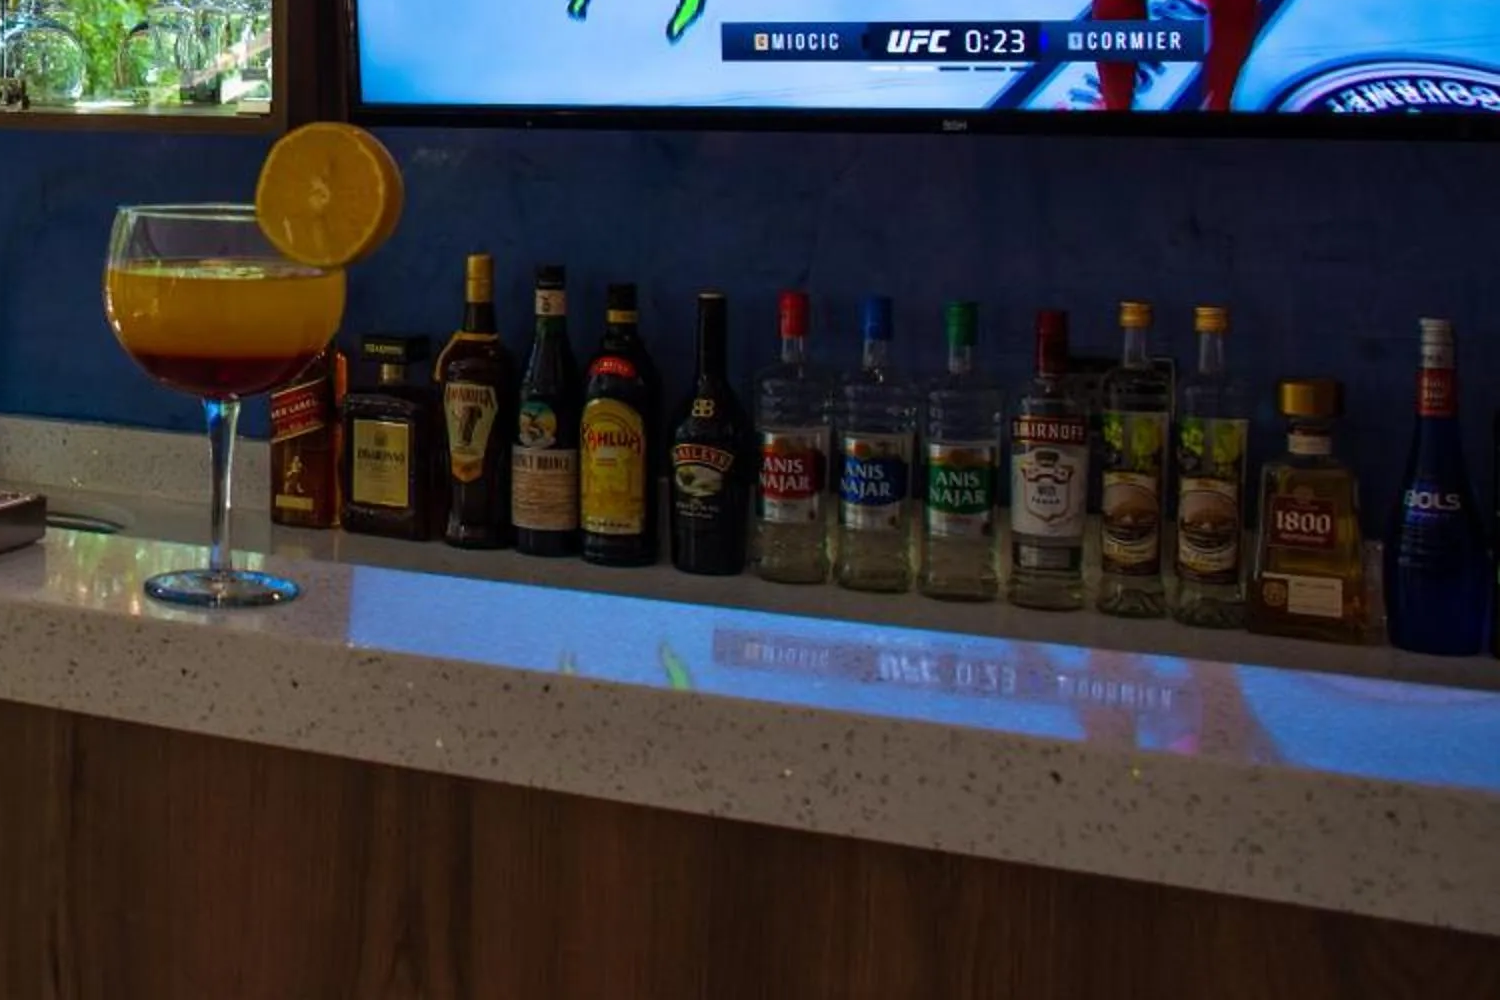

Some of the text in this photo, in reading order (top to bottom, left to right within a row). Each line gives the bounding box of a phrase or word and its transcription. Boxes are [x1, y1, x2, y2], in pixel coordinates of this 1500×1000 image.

[771, 33, 840, 51] MIOCIC
[886, 29, 1026, 53] UFC 0:23
[1087, 31, 1182, 50] CORMIER
[1013, 420, 1084, 441] SMIRNOFF
[762, 457, 804, 474] ANIS
[844, 461, 885, 481] ANIS
[759, 473, 811, 493] NAJAR
[841, 479, 891, 499] NAJAR
[935, 470, 981, 488] ANIS
[928, 487, 987, 507] NAJAR
[1404, 489, 1462, 511] BOLS
[1274, 510, 1331, 535] 1800
